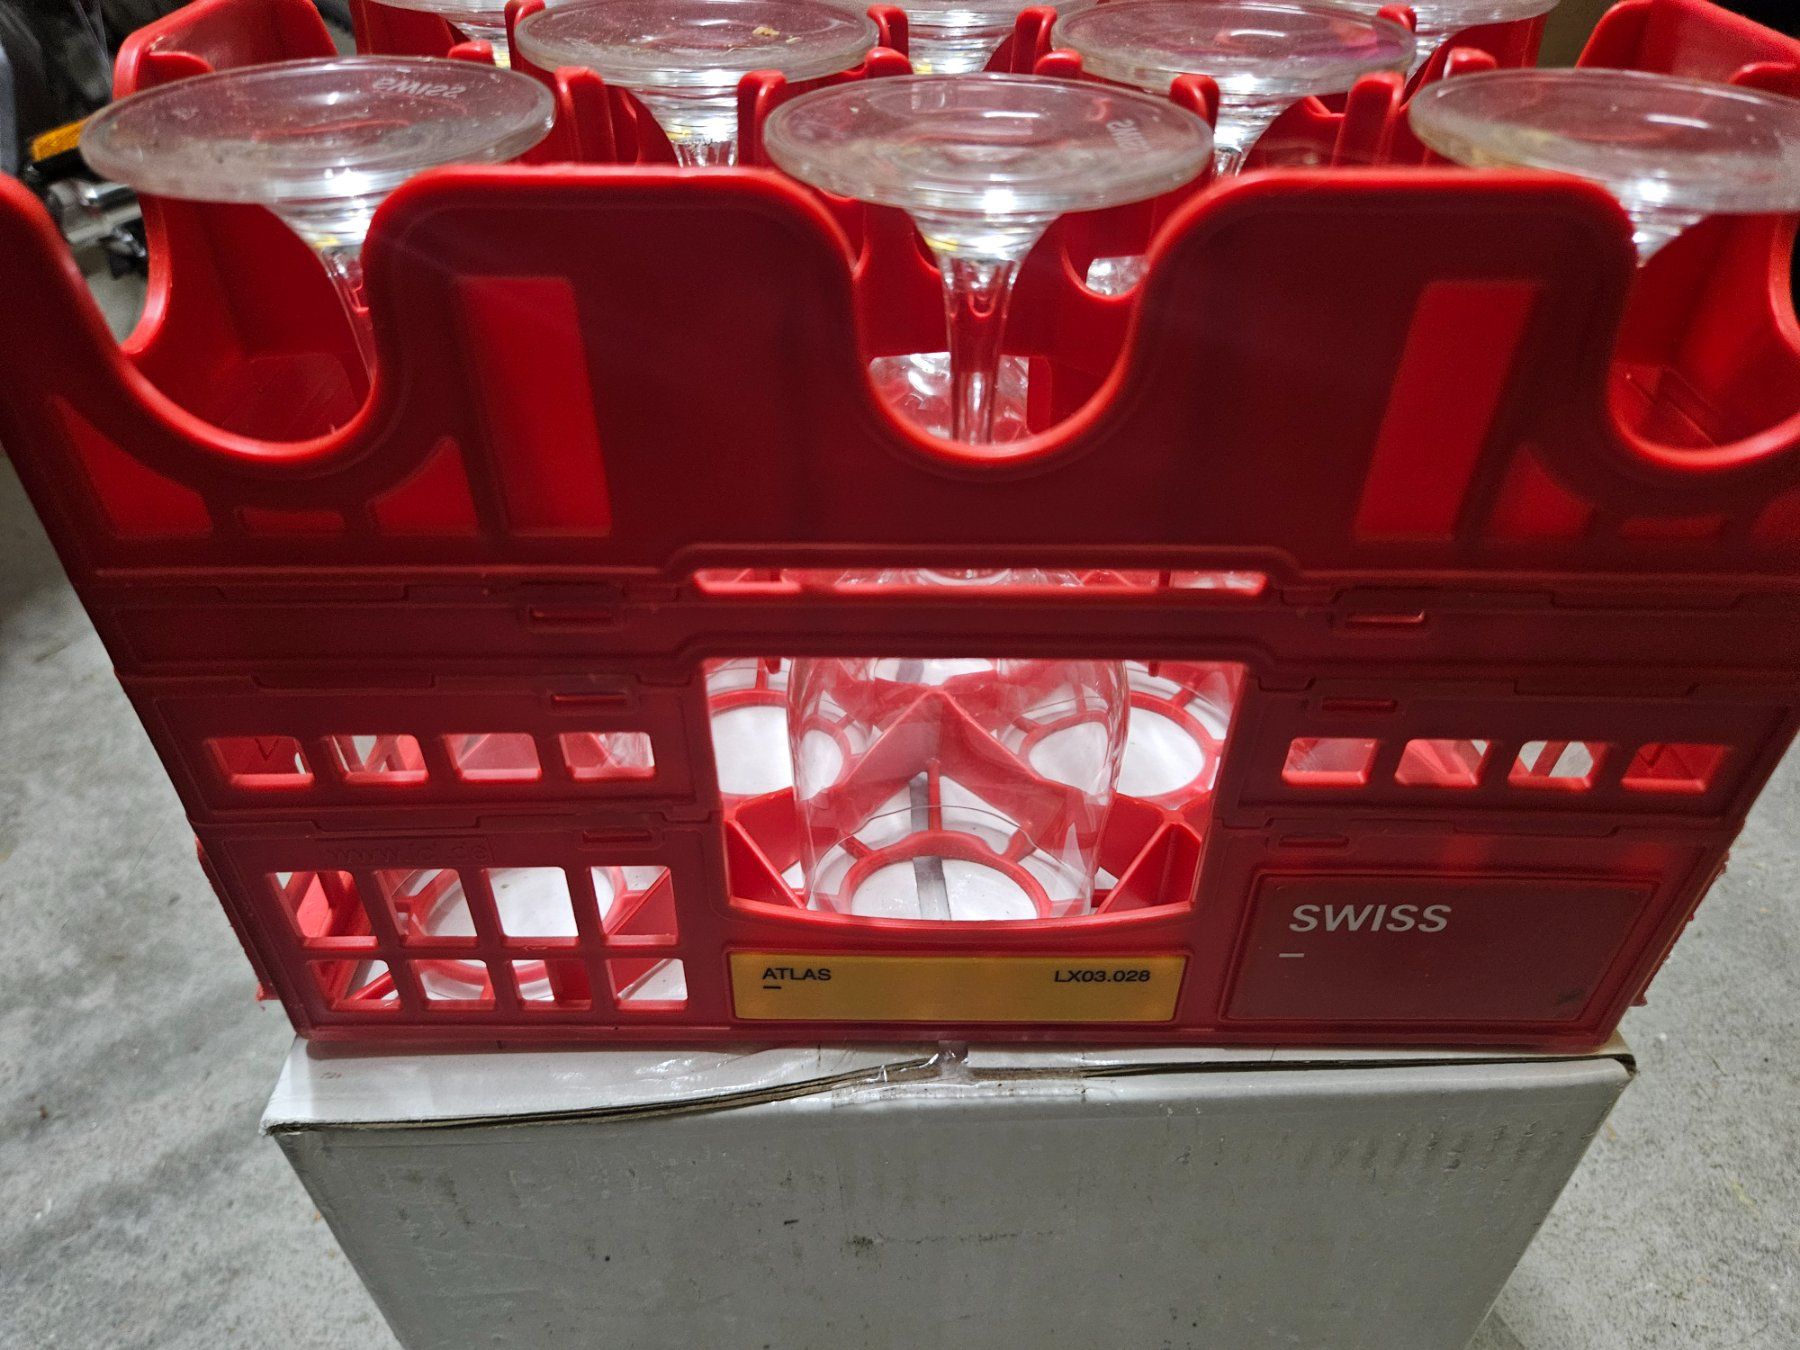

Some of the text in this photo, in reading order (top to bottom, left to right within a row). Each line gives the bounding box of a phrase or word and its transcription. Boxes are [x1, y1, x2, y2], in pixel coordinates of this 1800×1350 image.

[1288, 904, 1452, 933] SWISS
[762, 967, 832, 981] ATLAS
[1054, 969, 1151, 982] LX03.028
